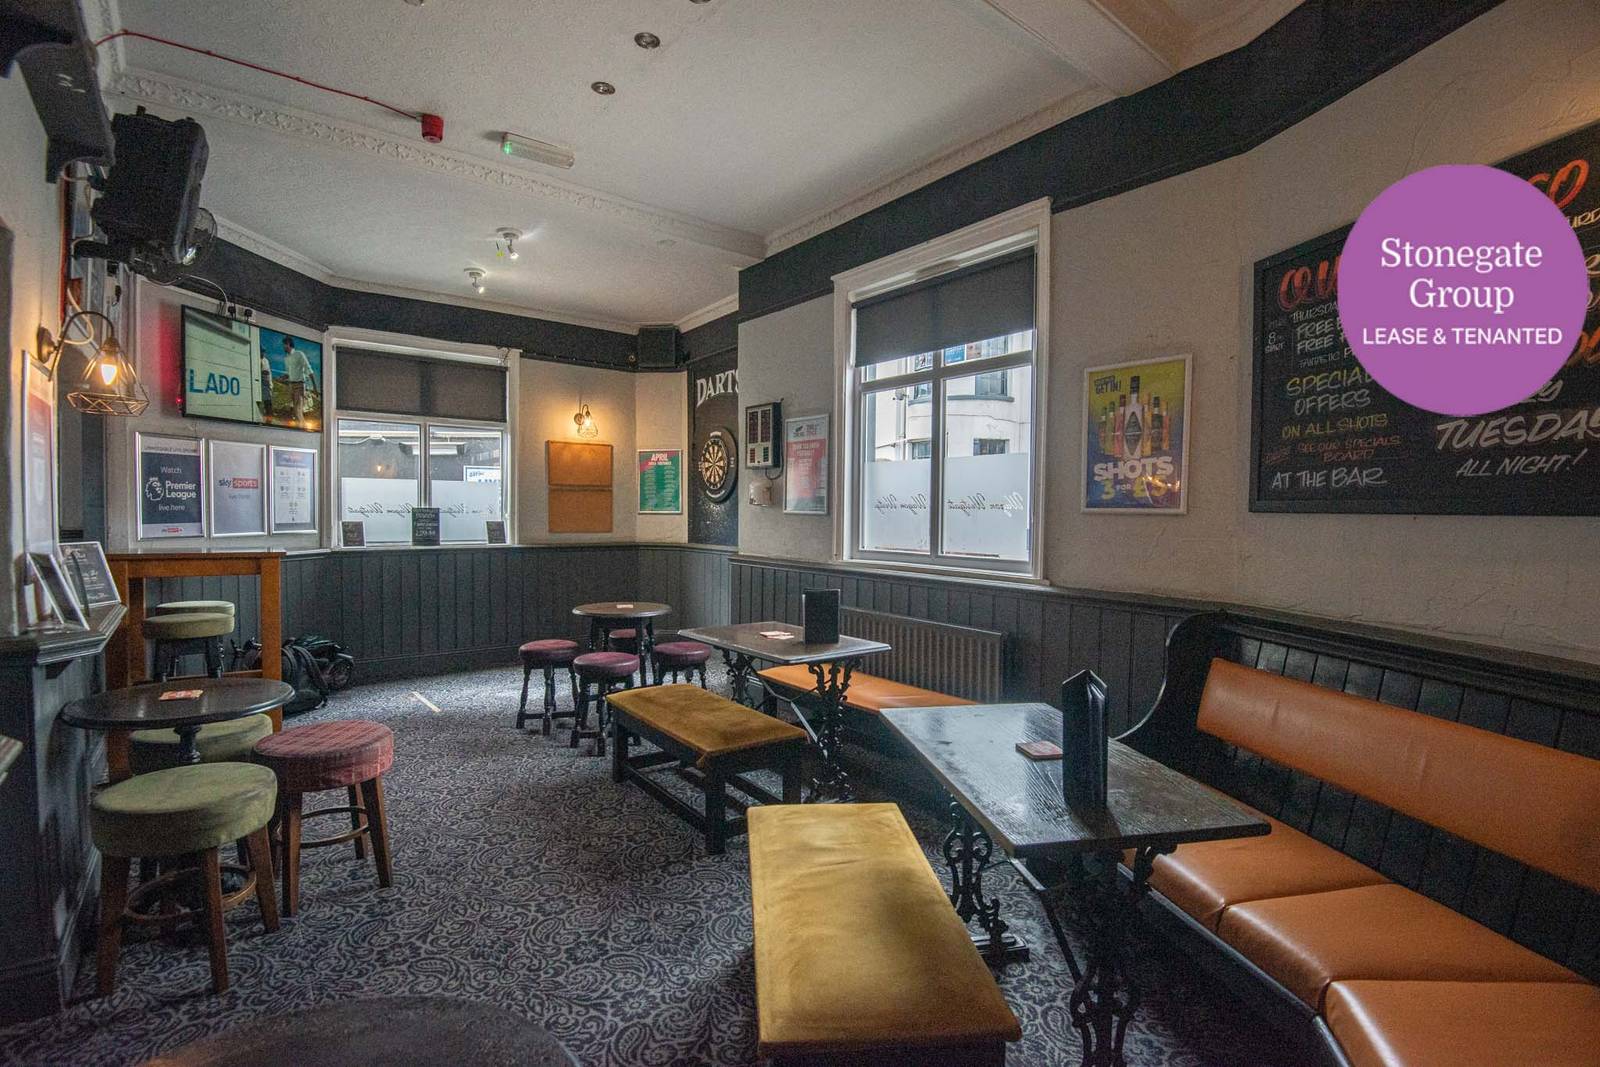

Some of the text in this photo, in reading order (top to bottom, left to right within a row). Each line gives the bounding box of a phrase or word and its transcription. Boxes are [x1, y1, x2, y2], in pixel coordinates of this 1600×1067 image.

[1291, 302, 1338, 322] THURSDA
[1296, 319, 1334, 340] FREE
[1297, 335, 1335, 354] FREE
[189, 369, 240, 396] LADO
[1294, 388, 1372, 416] OFFERS
[1281, 413, 1388, 439] ON ALL SHOTS
[160, 466, 182, 474] Watch
[1093, 456, 1174, 482] SHOTS
[1455, 458, 1492, 477] ALL
[165, 480, 197, 490] Premier
[233, 480, 258, 488] sports
[1271, 467, 1388, 489] AT THE BAR
[165, 489, 197, 500] League
[1101, 478, 1115, 500] 3
